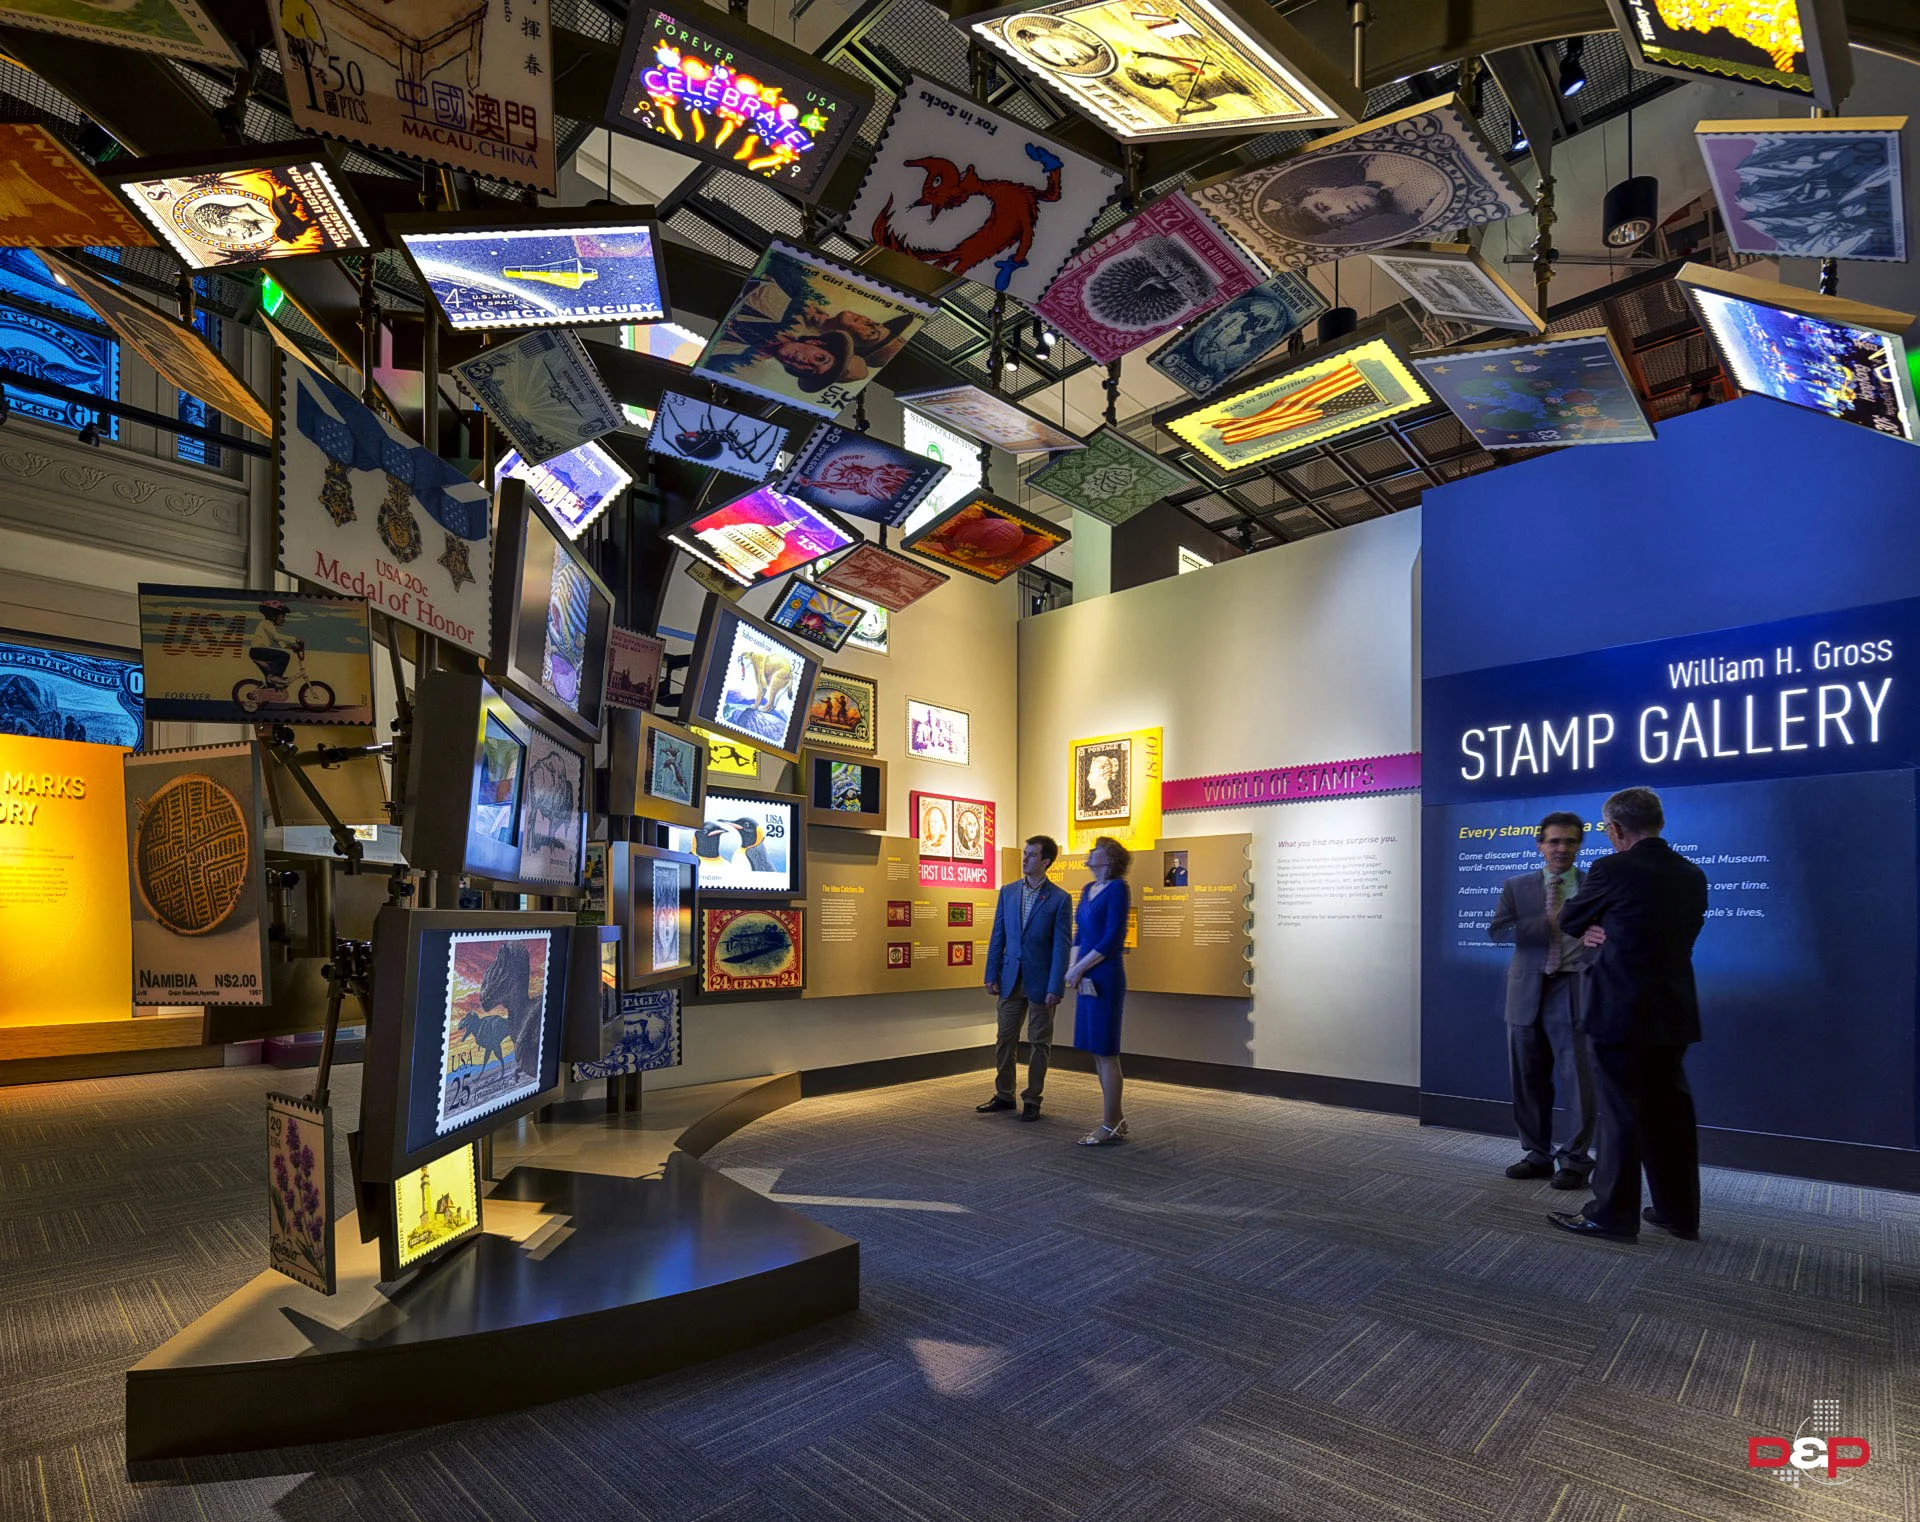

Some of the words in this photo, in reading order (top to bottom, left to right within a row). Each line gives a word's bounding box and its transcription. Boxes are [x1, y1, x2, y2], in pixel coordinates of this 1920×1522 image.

[657, 11, 676, 26] 2011
[653, 19, 735, 64] FOREVER
[395, 73, 539, 152] 中國澳門
[643, 69, 816, 154] CELEBRATE!
[806, 91, 837, 113] USA
[918, 89, 958, 117] Socks
[958, 109, 974, 126] in
[975, 122, 999, 137] Fox
[286, 165, 325, 214] UGANDA
[303, 170, 353, 242] TANGANYIKA
[317, 216, 348, 249] KENYA
[1184, 224, 1211, 254] STATE
[1208, 250, 1240, 281] JAIPUR
[821, 274, 844, 288] Girl
[845, 281, 893, 310] Scouting
[450, 308, 547, 322] PROJECT
[553, 302, 655, 317] MERCURY
[1050, 312, 1099, 350] POSTAGE
[816, 384, 844, 405] USA
[1255, 374, 1317, 400] Continuing
[668, 393, 687, 407] 33
[1305, 405, 1379, 436] HONORING
[1539, 429, 1562, 441] 33
[585, 457, 604, 478] House
[803, 441, 832, 477] POSTAGE
[839, 454, 866, 462] TRUST
[727, 465, 742, 476] Black
[765, 487, 790, 506] USA
[883, 467, 932, 522] LIBERTY
[374, 558, 403, 585] USA
[404, 573, 429, 597] 20c
[314, 550, 385, 605] Medal
[388, 592, 412, 616] of
[415, 598, 476, 645] Honor
[161, 611, 247, 659] USA
[789, 658, 802, 676] 32
[1668, 652, 1765, 689] William
[1775, 646, 1802, 676] H.
[1813, 638, 1895, 672] Gross
[164, 691, 212, 701] FOREVER
[1459, 711, 1616, 782] STAMP
[1637, 676, 1895, 765] GALLERY
[1087, 743, 1119, 753] POSTAGE
[3, 769, 87, 800] MARKS
[1202, 774, 1265, 802] WORLD
[1269, 771, 1291, 796] OF
[1296, 762, 1376, 794] STAMPS
[765, 813, 784, 825] USA
[983, 804, 995, 845] 1847
[765, 824, 786, 838] 29
[1458, 826, 1497, 840] Every
[1499, 825, 1542, 838] stamp
[1583, 824, 1592, 832] a
[1278, 841, 1297, 849] What
[1297, 841, 1311, 849] you
[1329, 838, 1344, 846] may
[1345, 836, 1379, 845] surprise
[1380, 836, 1398, 845] you.
[1458, 852, 1483, 861] Come
[1484, 851, 1521, 860] discover
[1522, 850, 1537, 858] the
[1579, 847, 1613, 856] stories
[1672, 843, 1698, 852] from
[1458, 862, 1529, 872] world-renowned
[1718, 854, 1770, 864] Museum.
[940, 866, 956, 881] U.S.
[957, 866, 988, 883] STAMPS
[1458, 886, 1489, 895] Admire
[1490, 886, 1505, 895] the
[1713, 882, 1739, 890] over
[1741, 881, 1770, 890] time.
[1458, 909, 1484, 918] Learn
[1736, 907, 1765, 918] lives,
[1458, 921, 1475, 929] and
[139, 969, 198, 988] NAMIBIA
[214, 972, 257, 988] N$2.00
[712, 975, 731, 990] 24
[733, 978, 777, 990] CENTS
[781, 972, 798, 985] 24
[623, 997, 657, 1008] TAGE
[450, 1050, 474, 1073] USA
[448, 1072, 473, 1112] 25
[269, 1116, 283, 1138] 29
[269, 1136, 282, 1150] USA
[396, 1179, 405, 1224] STATEHO
[398, 1226, 407, 1259] MAINE
